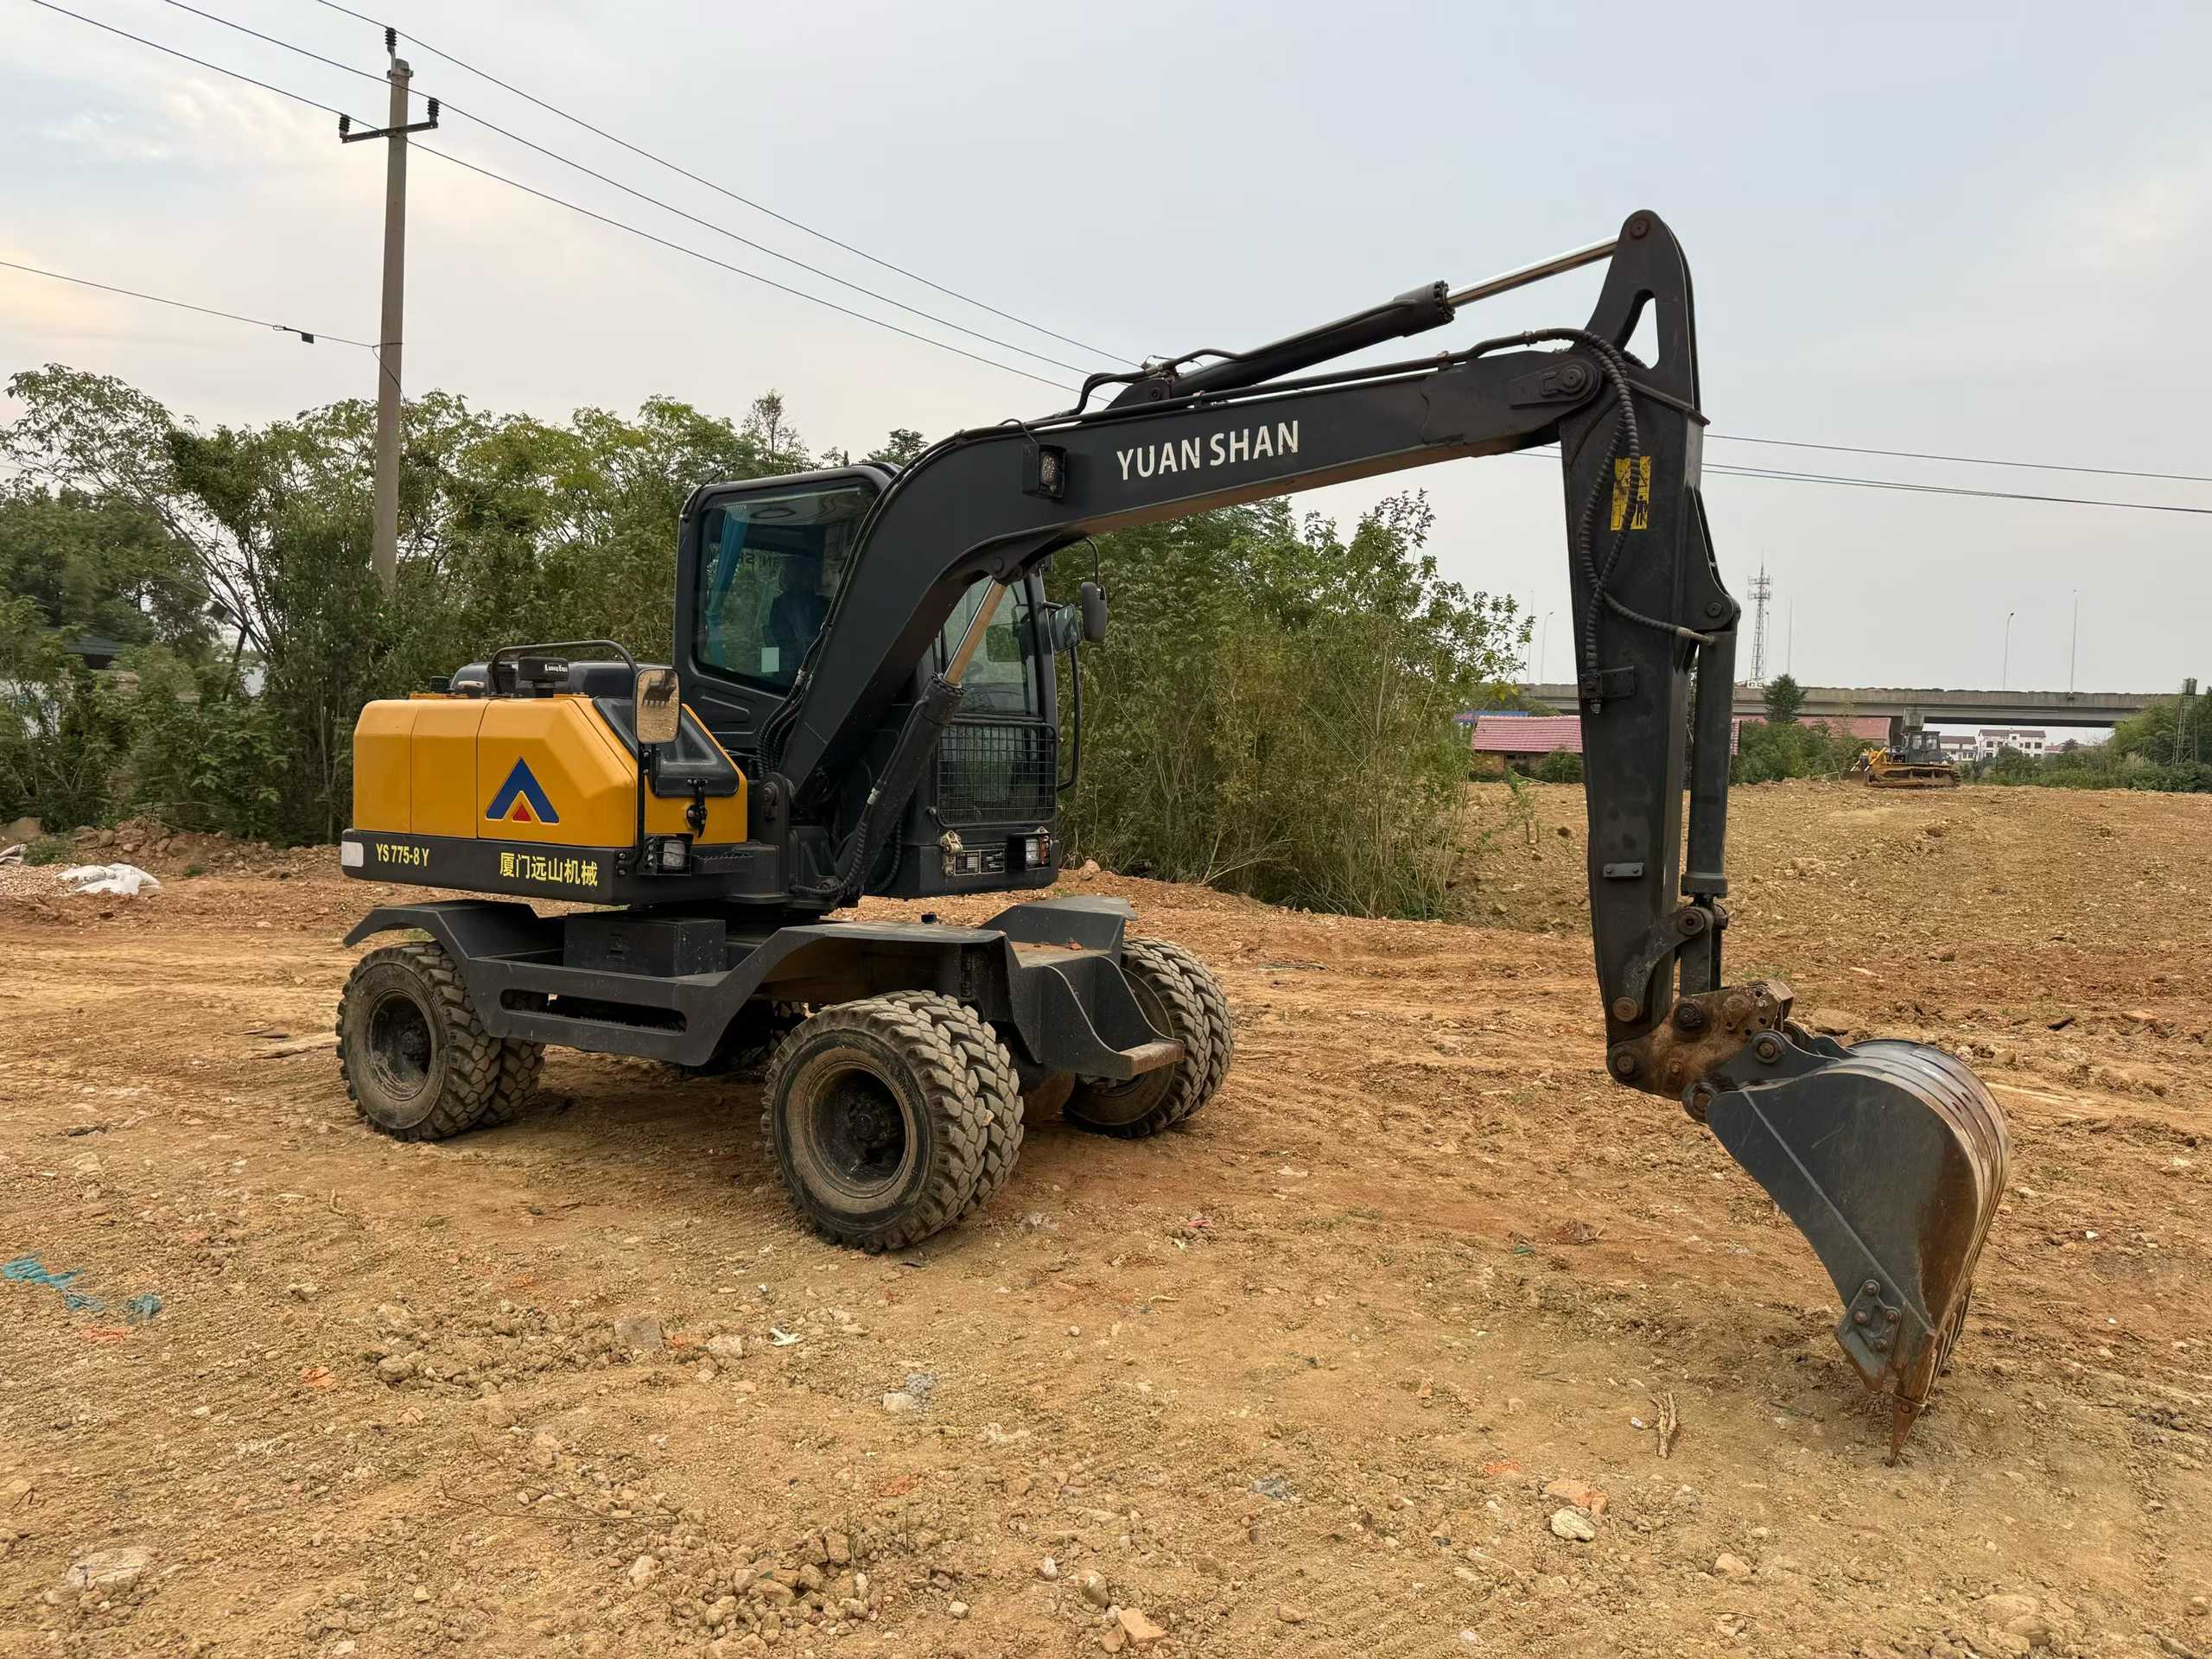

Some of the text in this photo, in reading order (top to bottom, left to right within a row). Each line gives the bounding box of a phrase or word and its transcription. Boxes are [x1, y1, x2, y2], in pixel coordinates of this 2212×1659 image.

[1116, 420, 1299, 481] YUAN SHAN
[499, 851, 598, 887] 厦门远山机械
